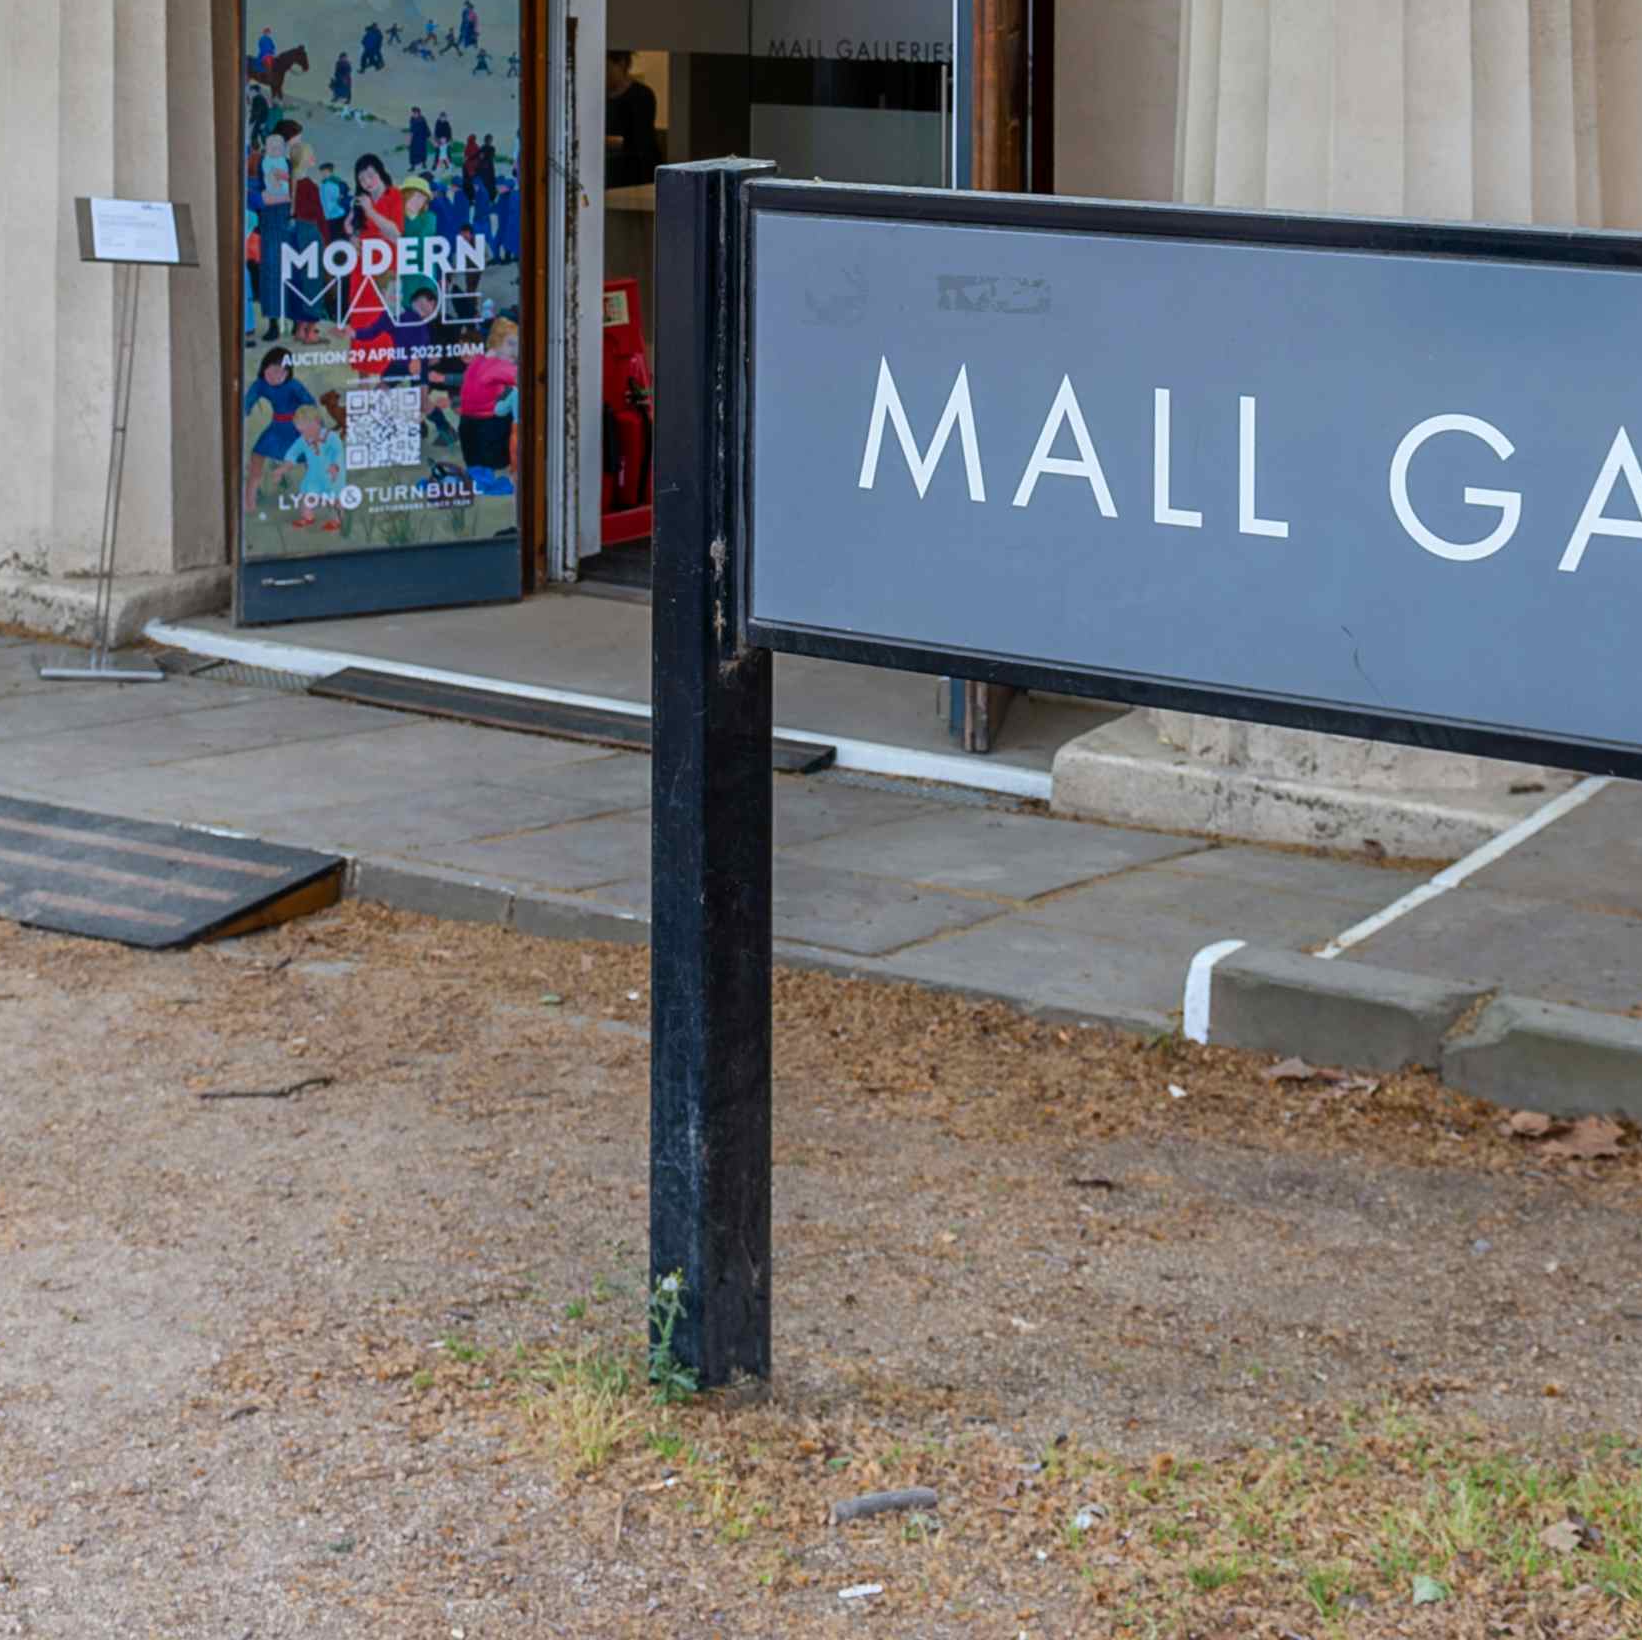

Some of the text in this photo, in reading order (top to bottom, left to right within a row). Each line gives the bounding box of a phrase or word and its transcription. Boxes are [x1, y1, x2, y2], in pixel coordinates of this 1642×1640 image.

[280, 234, 486, 279] MODERN
[280, 269, 485, 334] MADE
[281, 342, 485, 367] AUCTION 29 APRIL 2022 10AM
[857, 355, 1290, 539] MALL
[278, 492, 336, 511] LYON
[365, 480, 483, 504] TURNBULL
